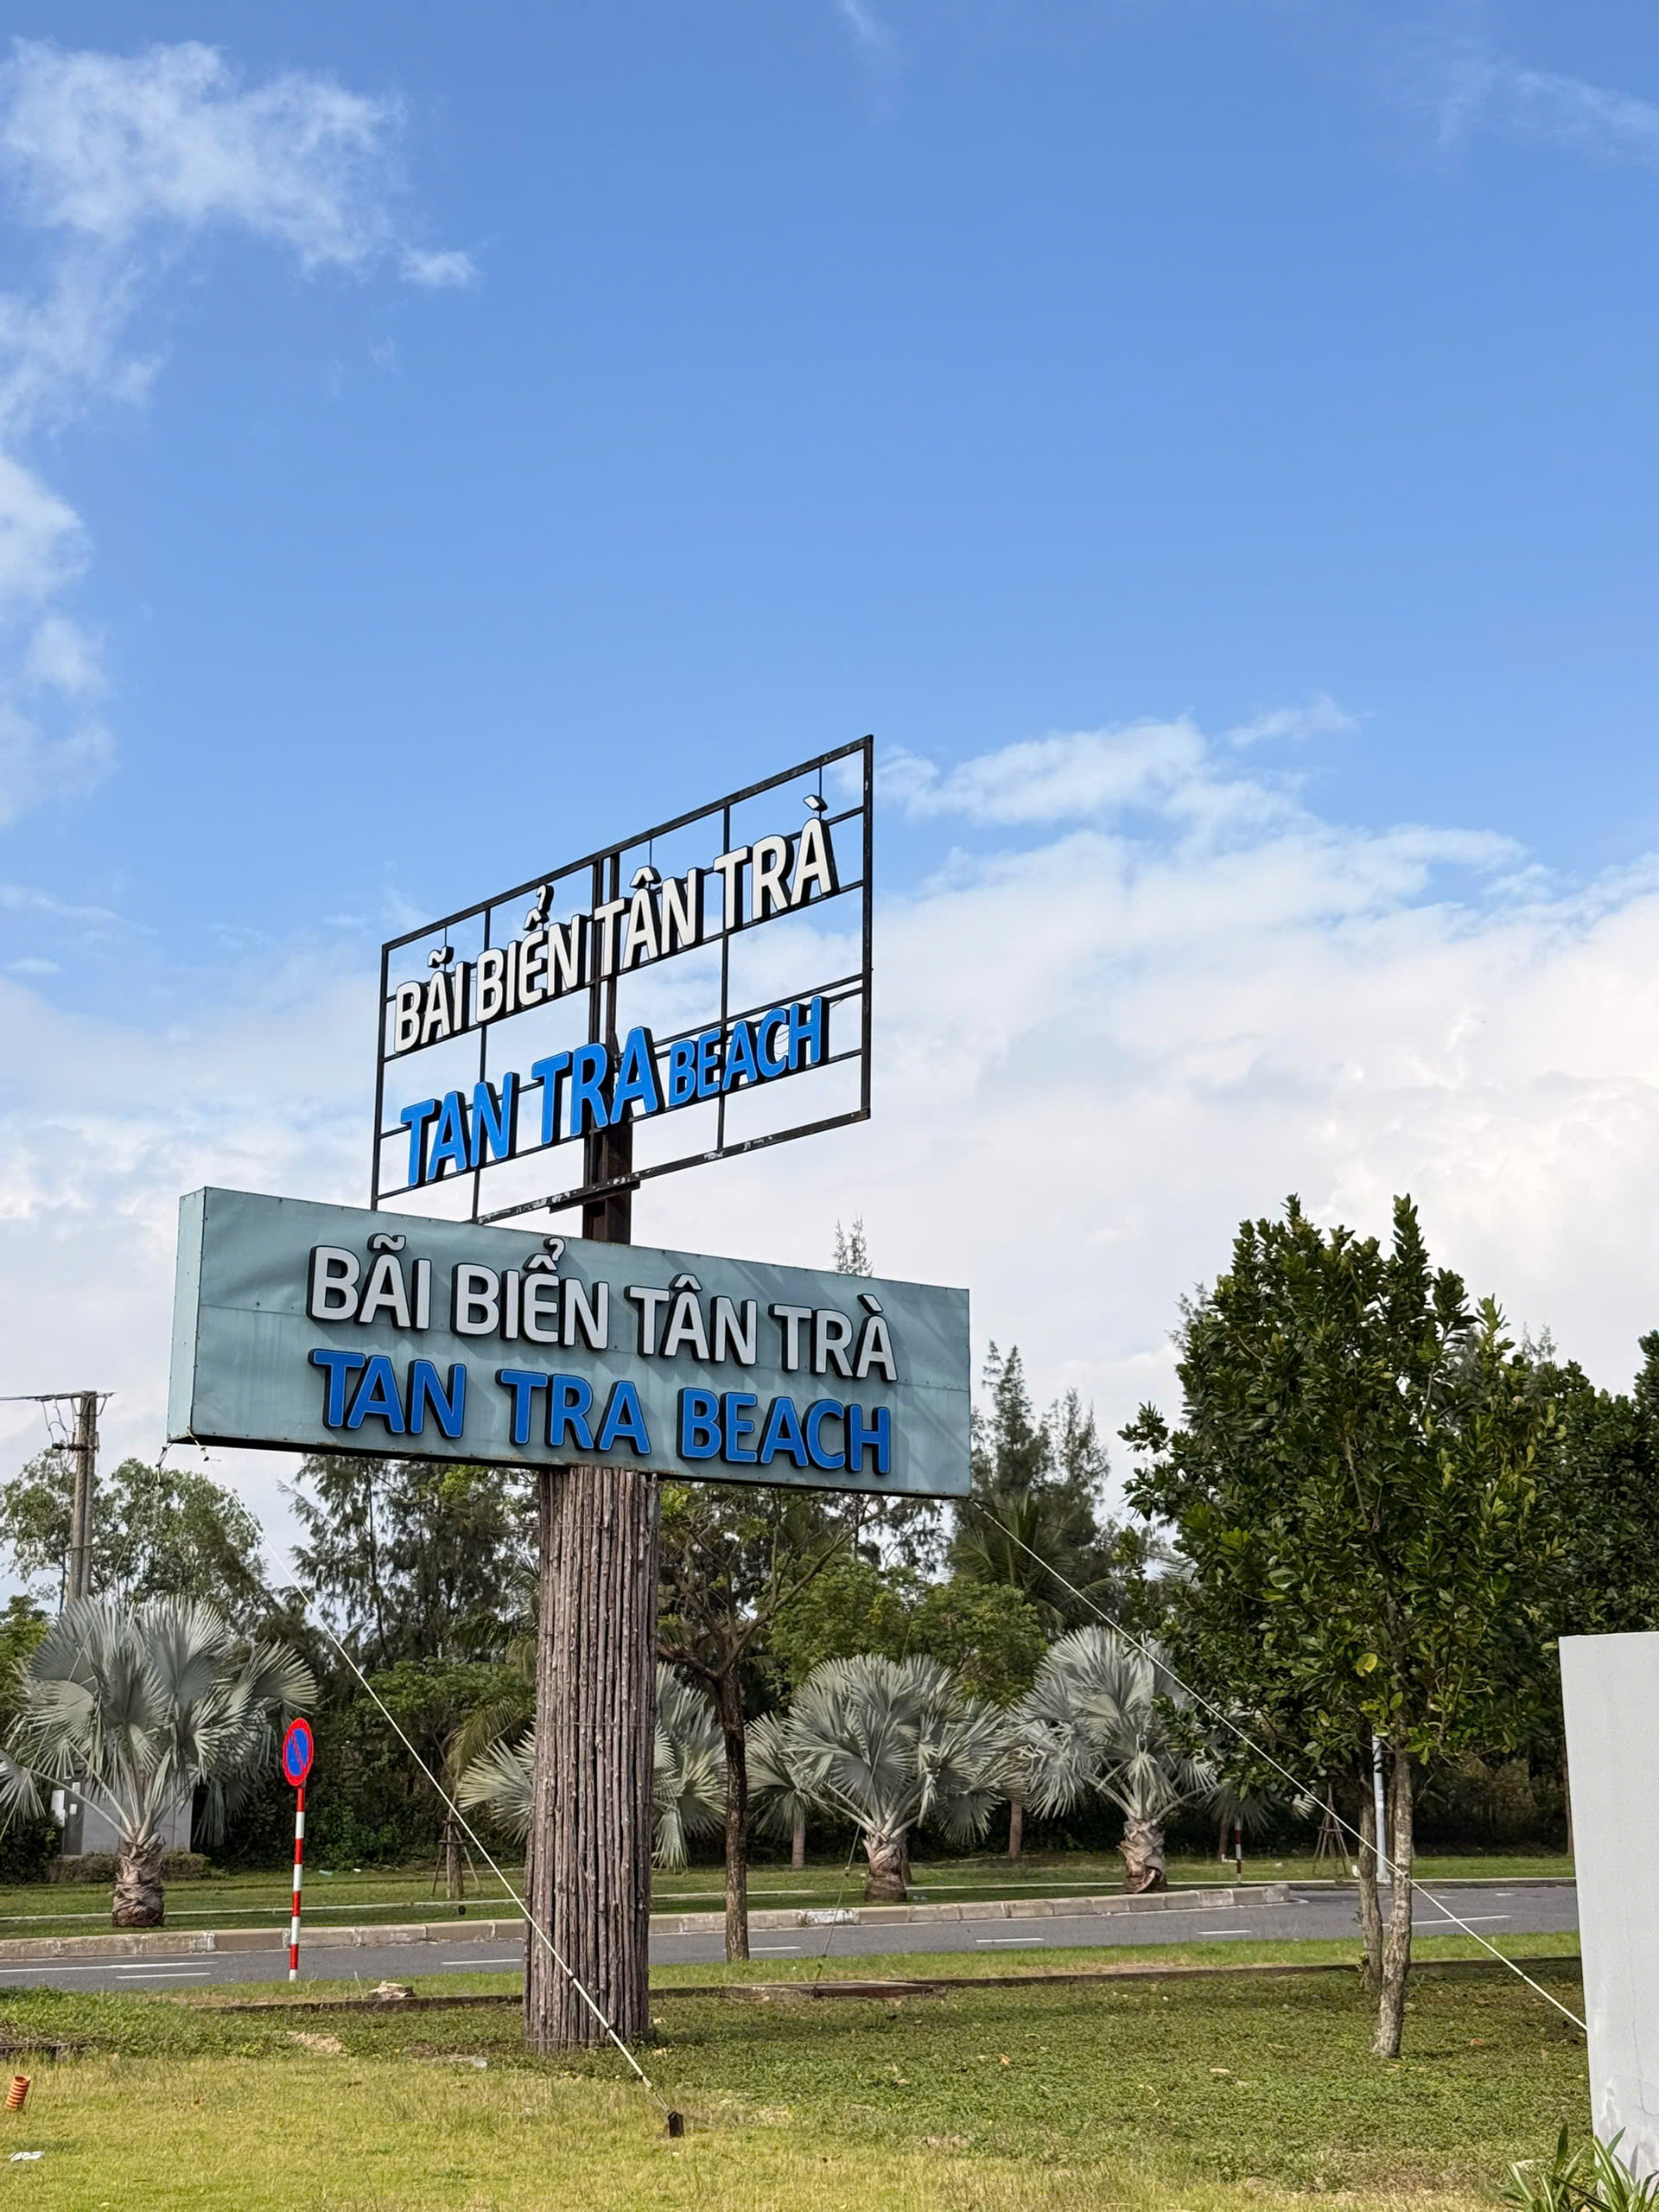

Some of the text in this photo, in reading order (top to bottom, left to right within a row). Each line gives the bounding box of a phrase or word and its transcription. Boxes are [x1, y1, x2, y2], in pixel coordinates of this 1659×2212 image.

[395, 793, 839, 1053] BÃI BIỂN TÂN TRÀ
[400, 995, 830, 1187] TAN TRA BEACH
[306, 1233, 898, 1382] BÃI BIỂN TÂN TRÀ
[308, 1348, 892, 1475] TAN TRA BEACH
